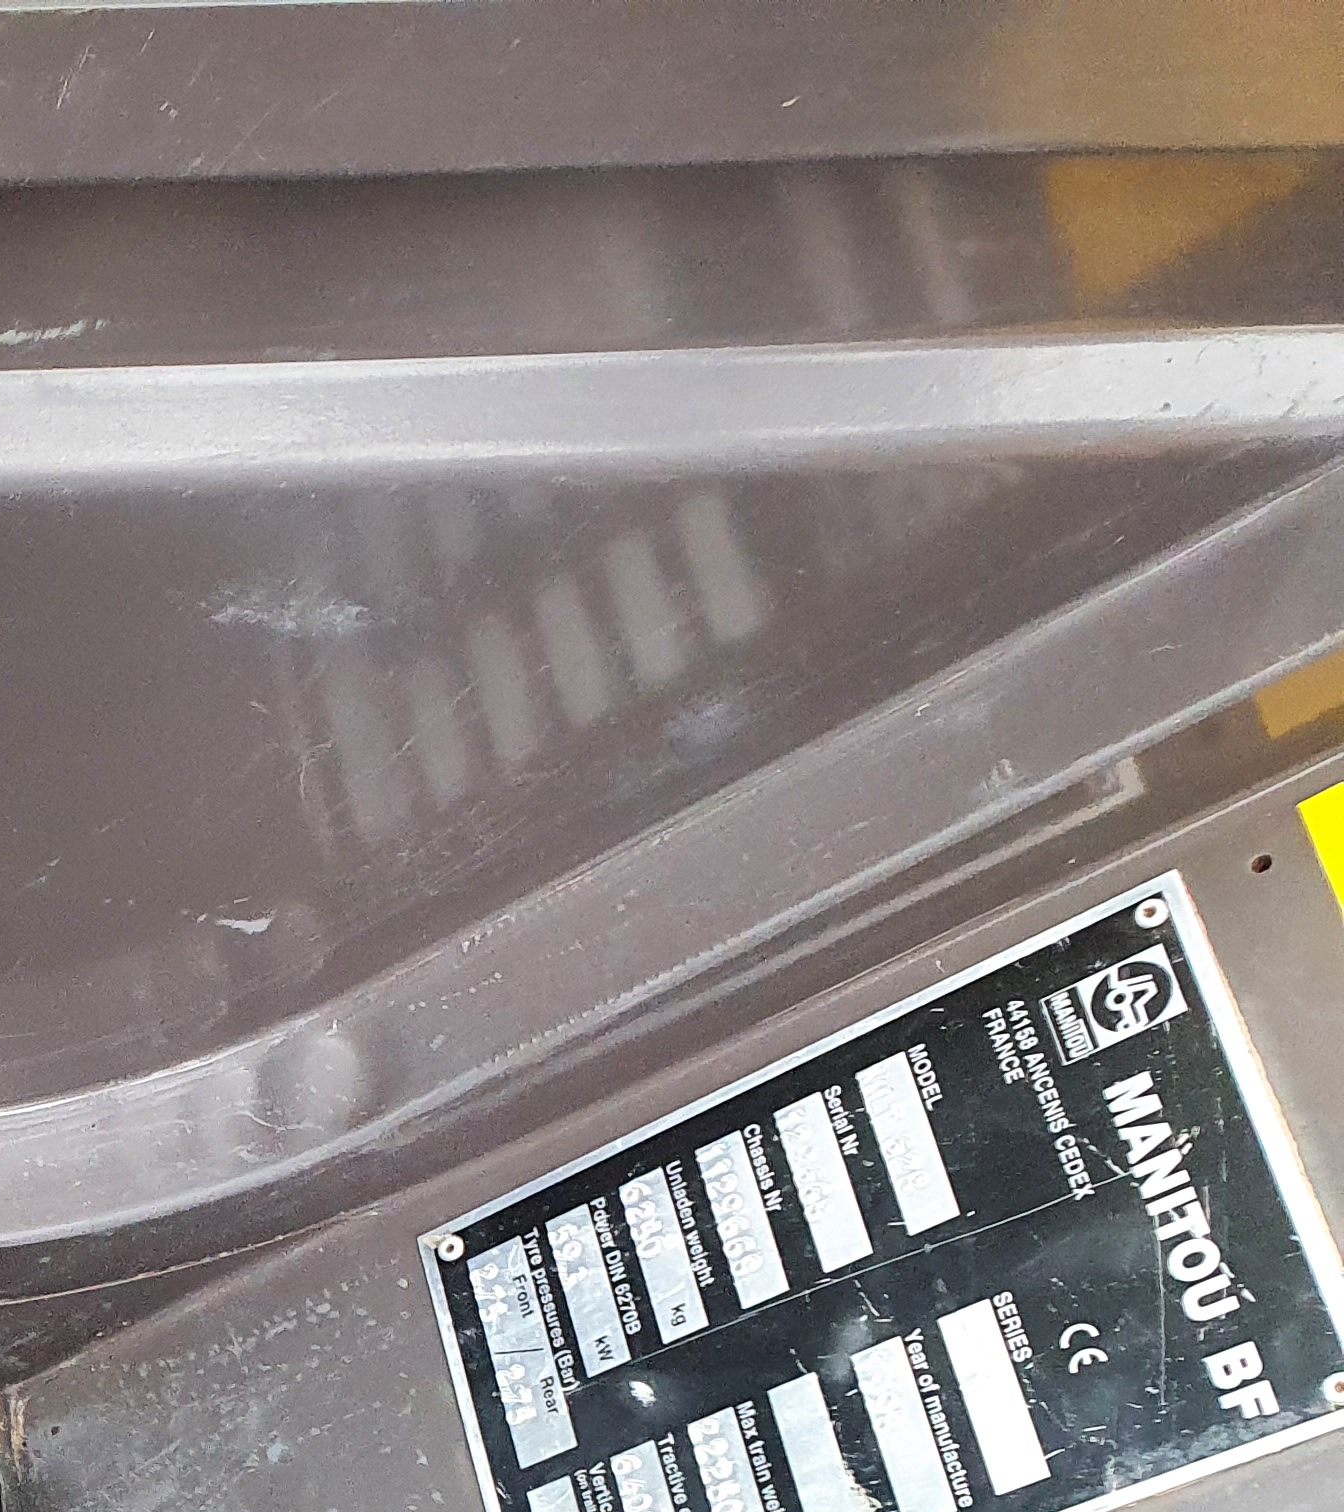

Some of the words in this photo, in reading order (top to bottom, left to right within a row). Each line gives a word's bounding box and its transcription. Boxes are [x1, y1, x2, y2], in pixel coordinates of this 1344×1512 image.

[981, 1007, 1025, 1084] FRANCE
[1051, 990, 1087, 1058] MANITOU
[823, 1084, 854, 1134] Serial
[907, 1043, 942, 1110] MODEL
[1006, 1000, 1038, 1050] 44158
[1023, 1052, 1070, 1133] ANCENIS
[1054, 1134, 1095, 1200] CEDEX
[743, 1123, 774, 1190] Chassis
[763, 1189, 782, 1211] Nr
[838, 1132, 859, 1155] Nr
[518, 1227, 542, 1268] Tyre
[589, 1196, 614, 1248] Power
[665, 1159, 695, 1229] Unladen
[681, 1229, 714, 1290] weight
[1103, 1071, 1238, 1320] MANITOU
[1202, 1341, 1279, 1418] BF
[605, 1249, 626, 1282] DIN
[529, 1267, 564, 1347] pressures
[614, 1282, 641, 1335] 6270B
[670, 1302, 686, 1327] kg
[992, 1291, 1032, 1362] SERIES
[511, 1273, 534, 1318] Front
[539, 1375, 558, 1413] Rear
[553, 1349, 580, 1391] (Bar)
[594, 1334, 614, 1361] kW
[904, 1327, 929, 1369] Year
[917, 1373, 940, 1392] of
[657, 1431, 687, 1504] Tractive
[735, 1400, 758, 1439] Max
[747, 1439, 771, 1482] train
[924, 1395, 973, 1507] manufacture
[573, 1468, 588, 1489] (on
